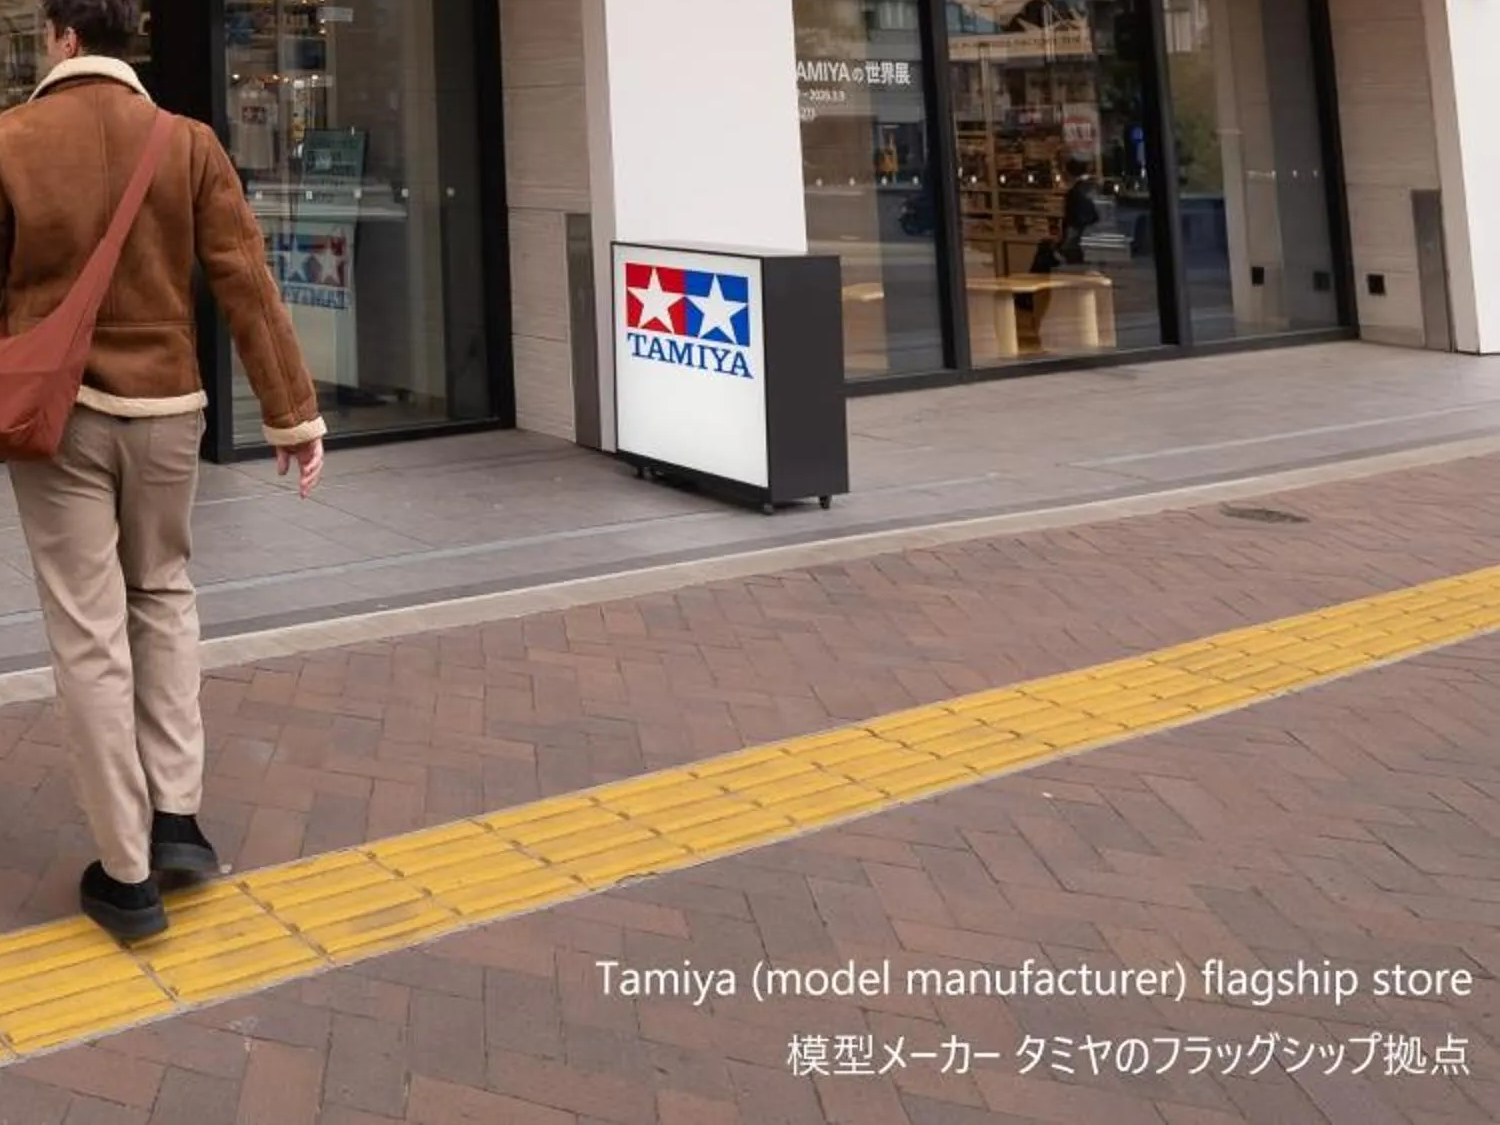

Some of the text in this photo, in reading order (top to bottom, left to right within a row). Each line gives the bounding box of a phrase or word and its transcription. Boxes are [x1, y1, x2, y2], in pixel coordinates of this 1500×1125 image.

[796, 60, 911, 85] AMIYAの世界展
[627, 332, 754, 379] TAMIYA
